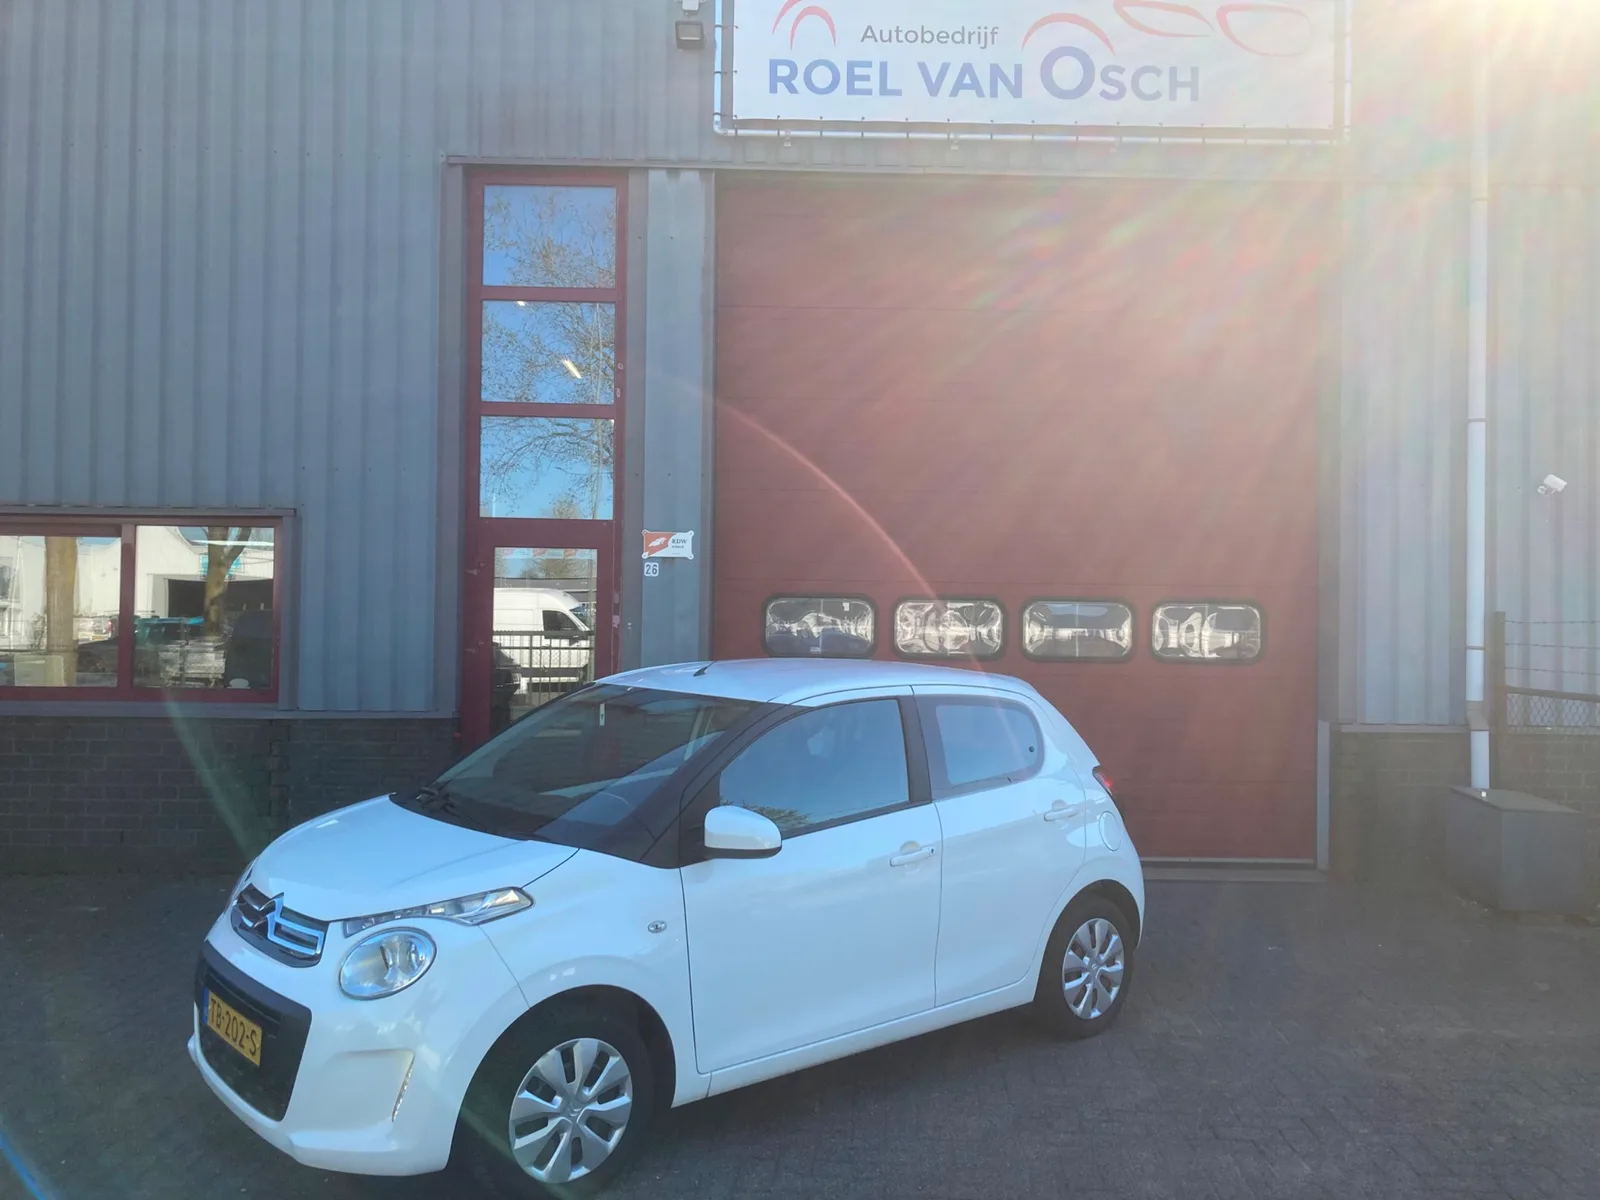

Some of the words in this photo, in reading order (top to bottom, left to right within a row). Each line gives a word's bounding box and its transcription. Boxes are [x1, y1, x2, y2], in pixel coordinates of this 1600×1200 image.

[860, 24, 1000, 49] Autobedrijf
[768, 58, 903, 97] ROEL
[917, 61, 1023, 99] VAN
[645, 563, 658, 575] 26
